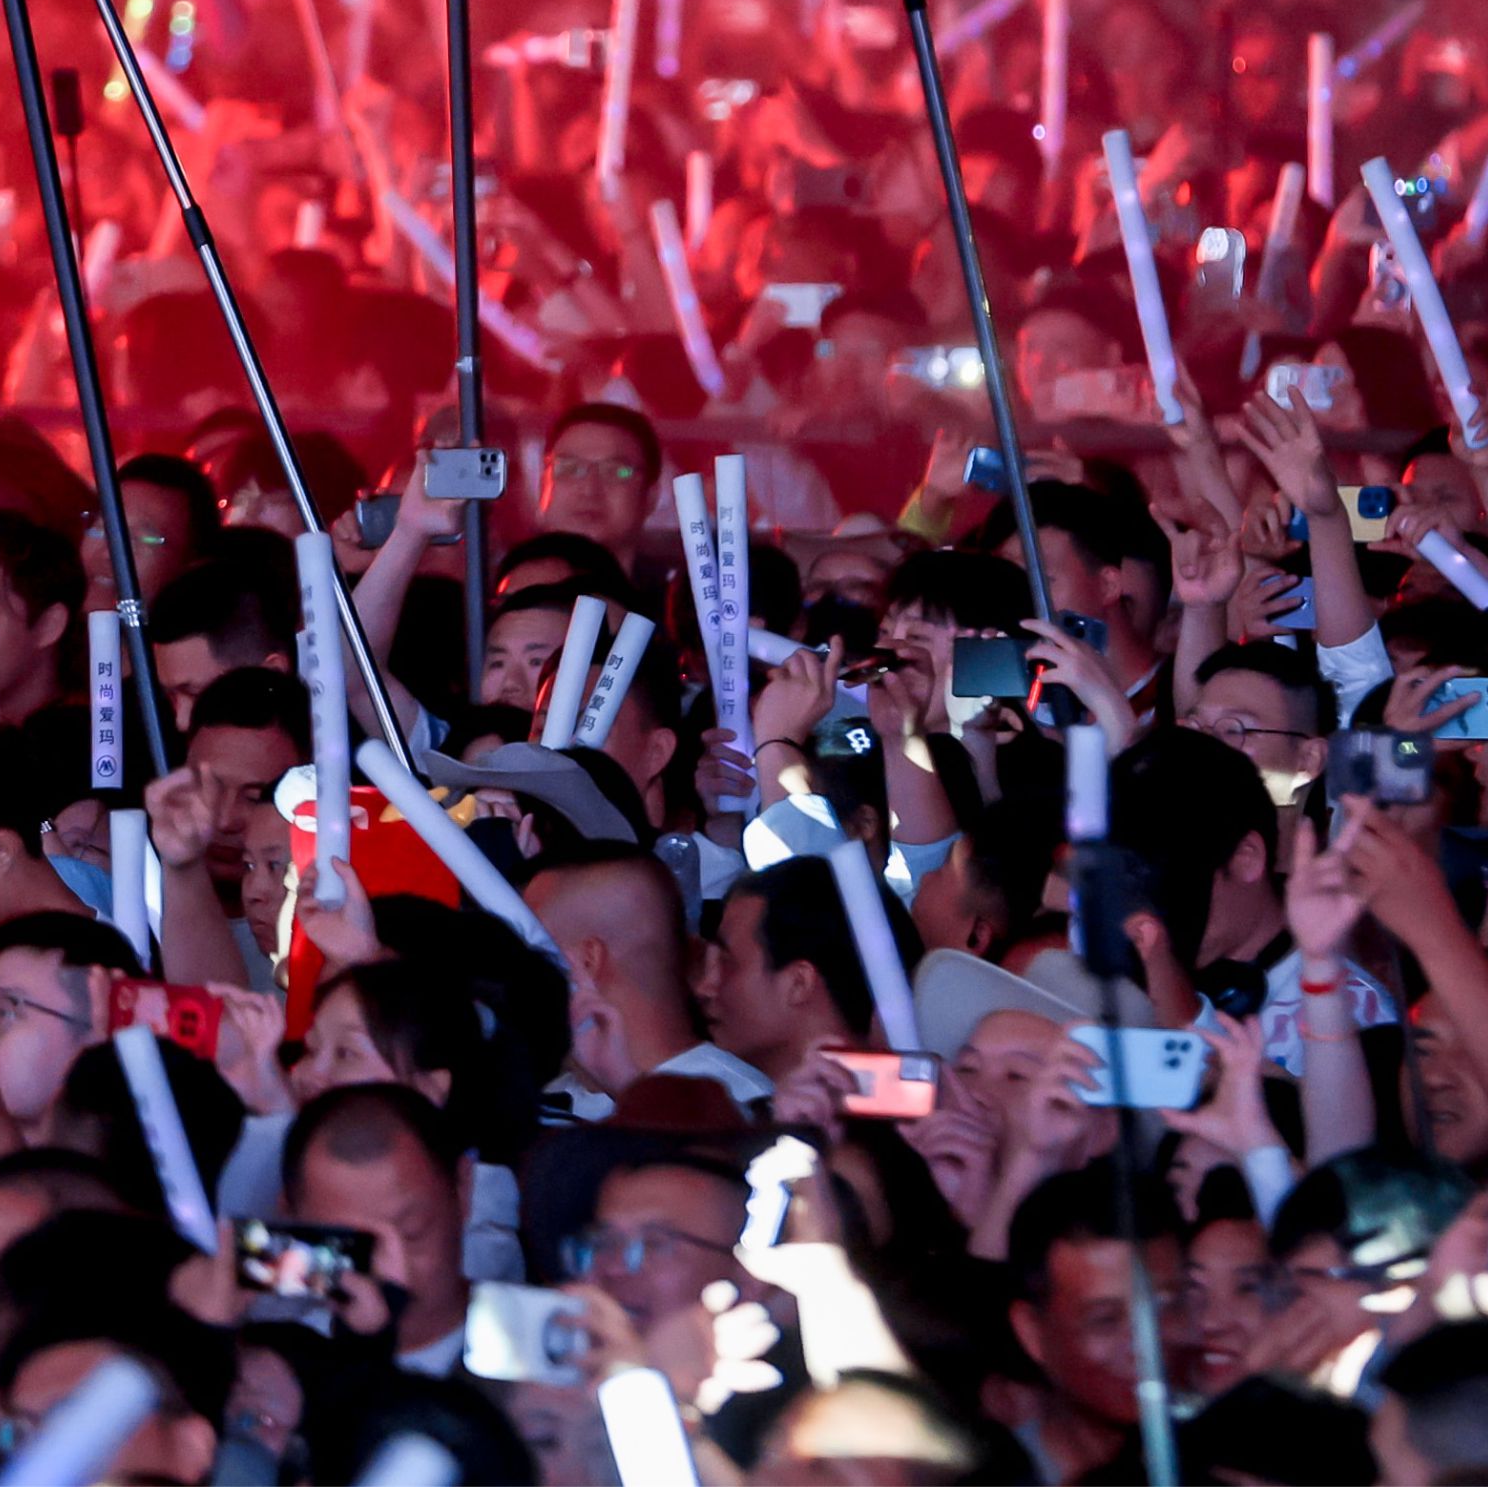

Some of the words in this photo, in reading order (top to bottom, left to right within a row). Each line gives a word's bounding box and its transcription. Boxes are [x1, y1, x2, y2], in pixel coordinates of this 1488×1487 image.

[97, 661, 115, 746] 时尚爱玛
[580, 654, 625, 732] 时尚爱玛
[721, 631, 737, 716] 自在出行
